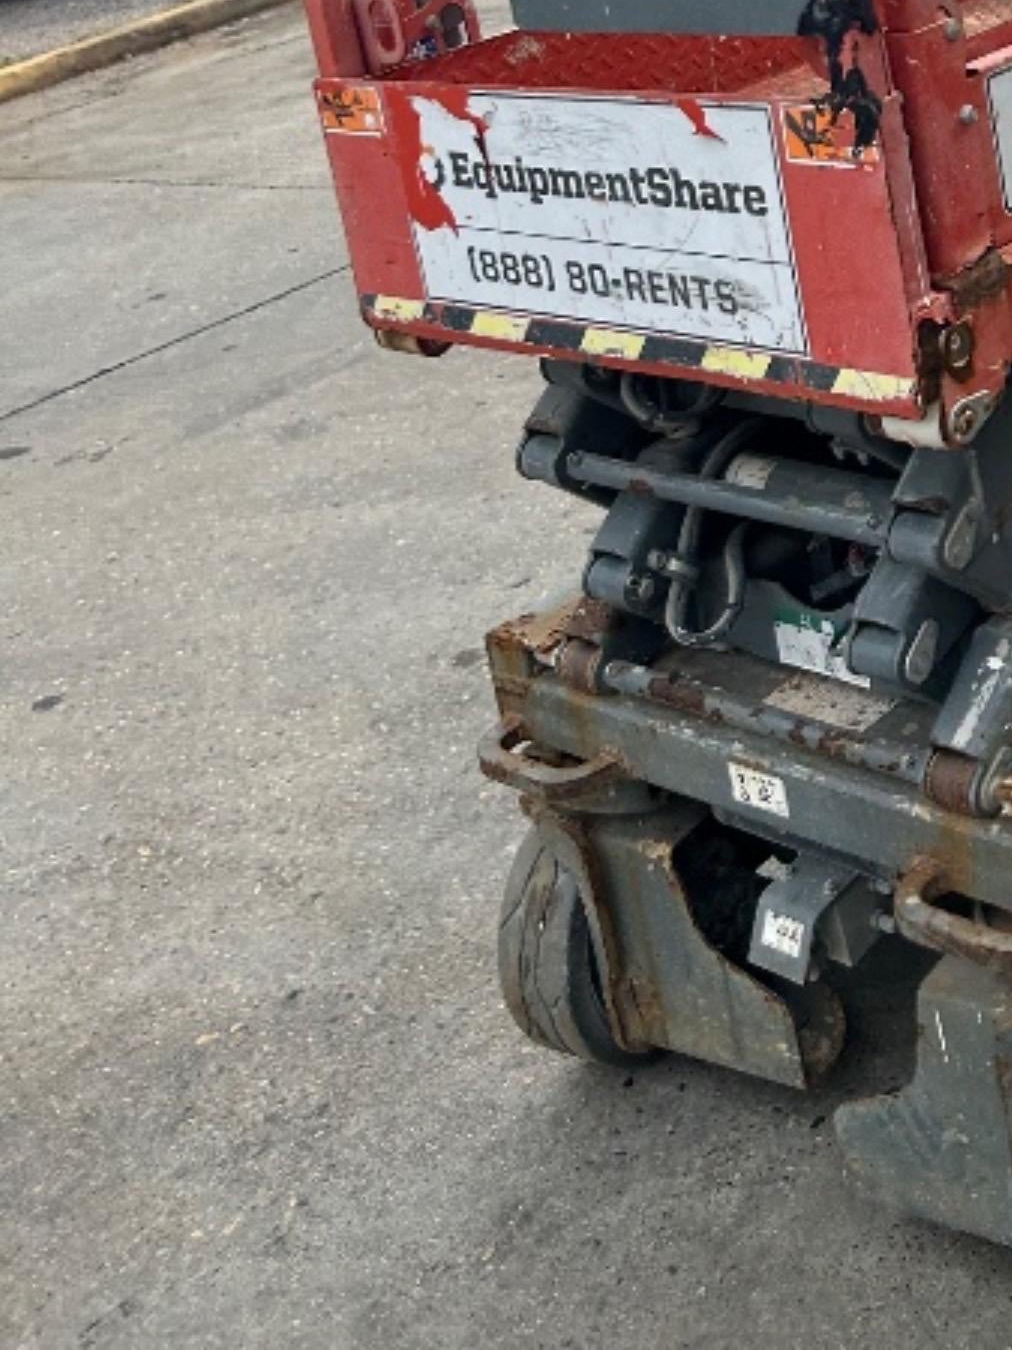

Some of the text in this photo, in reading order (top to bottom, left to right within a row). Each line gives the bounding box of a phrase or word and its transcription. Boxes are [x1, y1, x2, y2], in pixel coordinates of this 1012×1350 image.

[450, 152, 768, 216] EquipmentShare
[467, 245, 740, 315] (888) 80-RENTS
